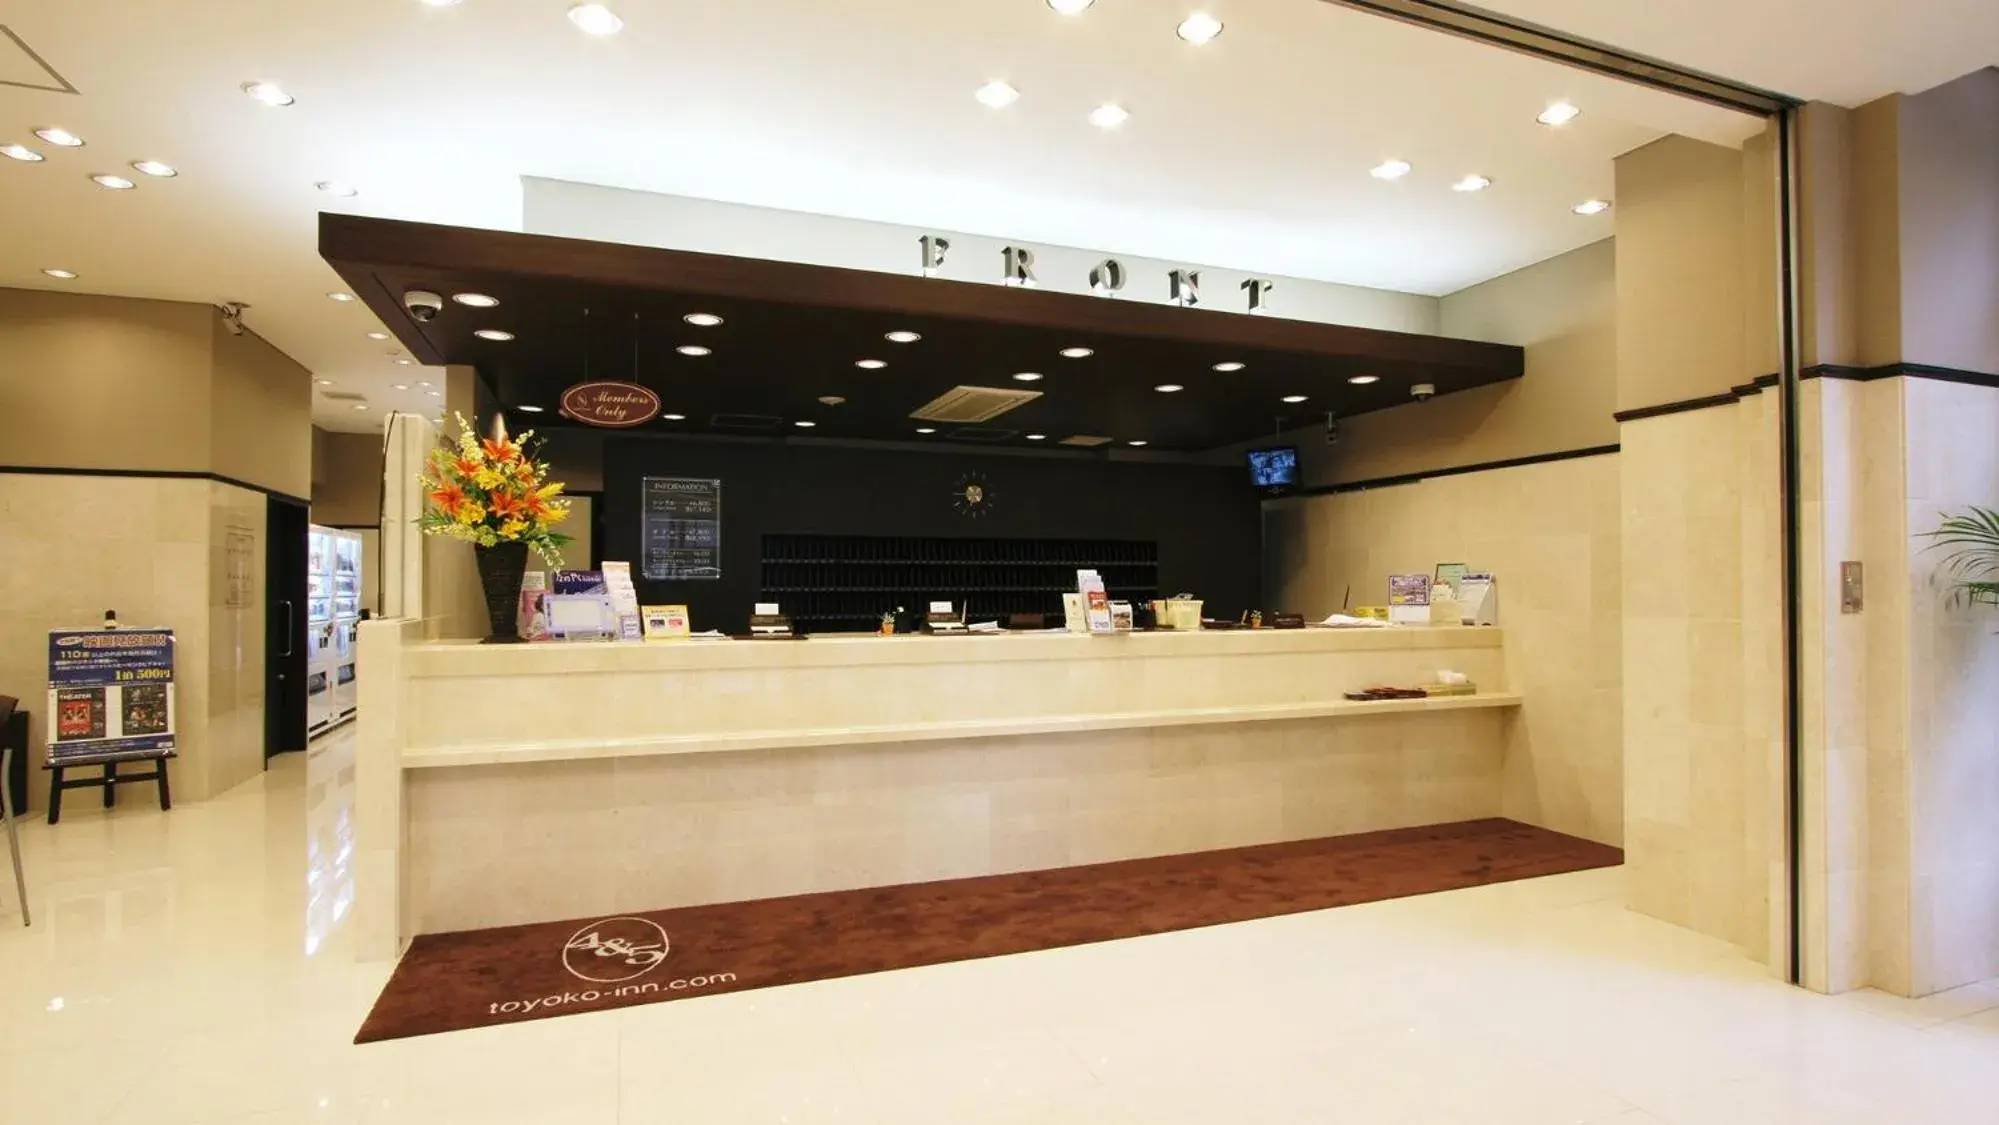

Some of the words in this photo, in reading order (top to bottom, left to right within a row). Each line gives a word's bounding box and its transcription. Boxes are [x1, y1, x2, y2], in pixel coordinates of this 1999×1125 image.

[918, 234, 1274, 310] FRONT
[592, 391, 649, 404] Members
[595, 405, 627, 420] Only
[654, 482, 708, 490] INFORMATION
[489, 971, 738, 1014] toyoko-inn.com
